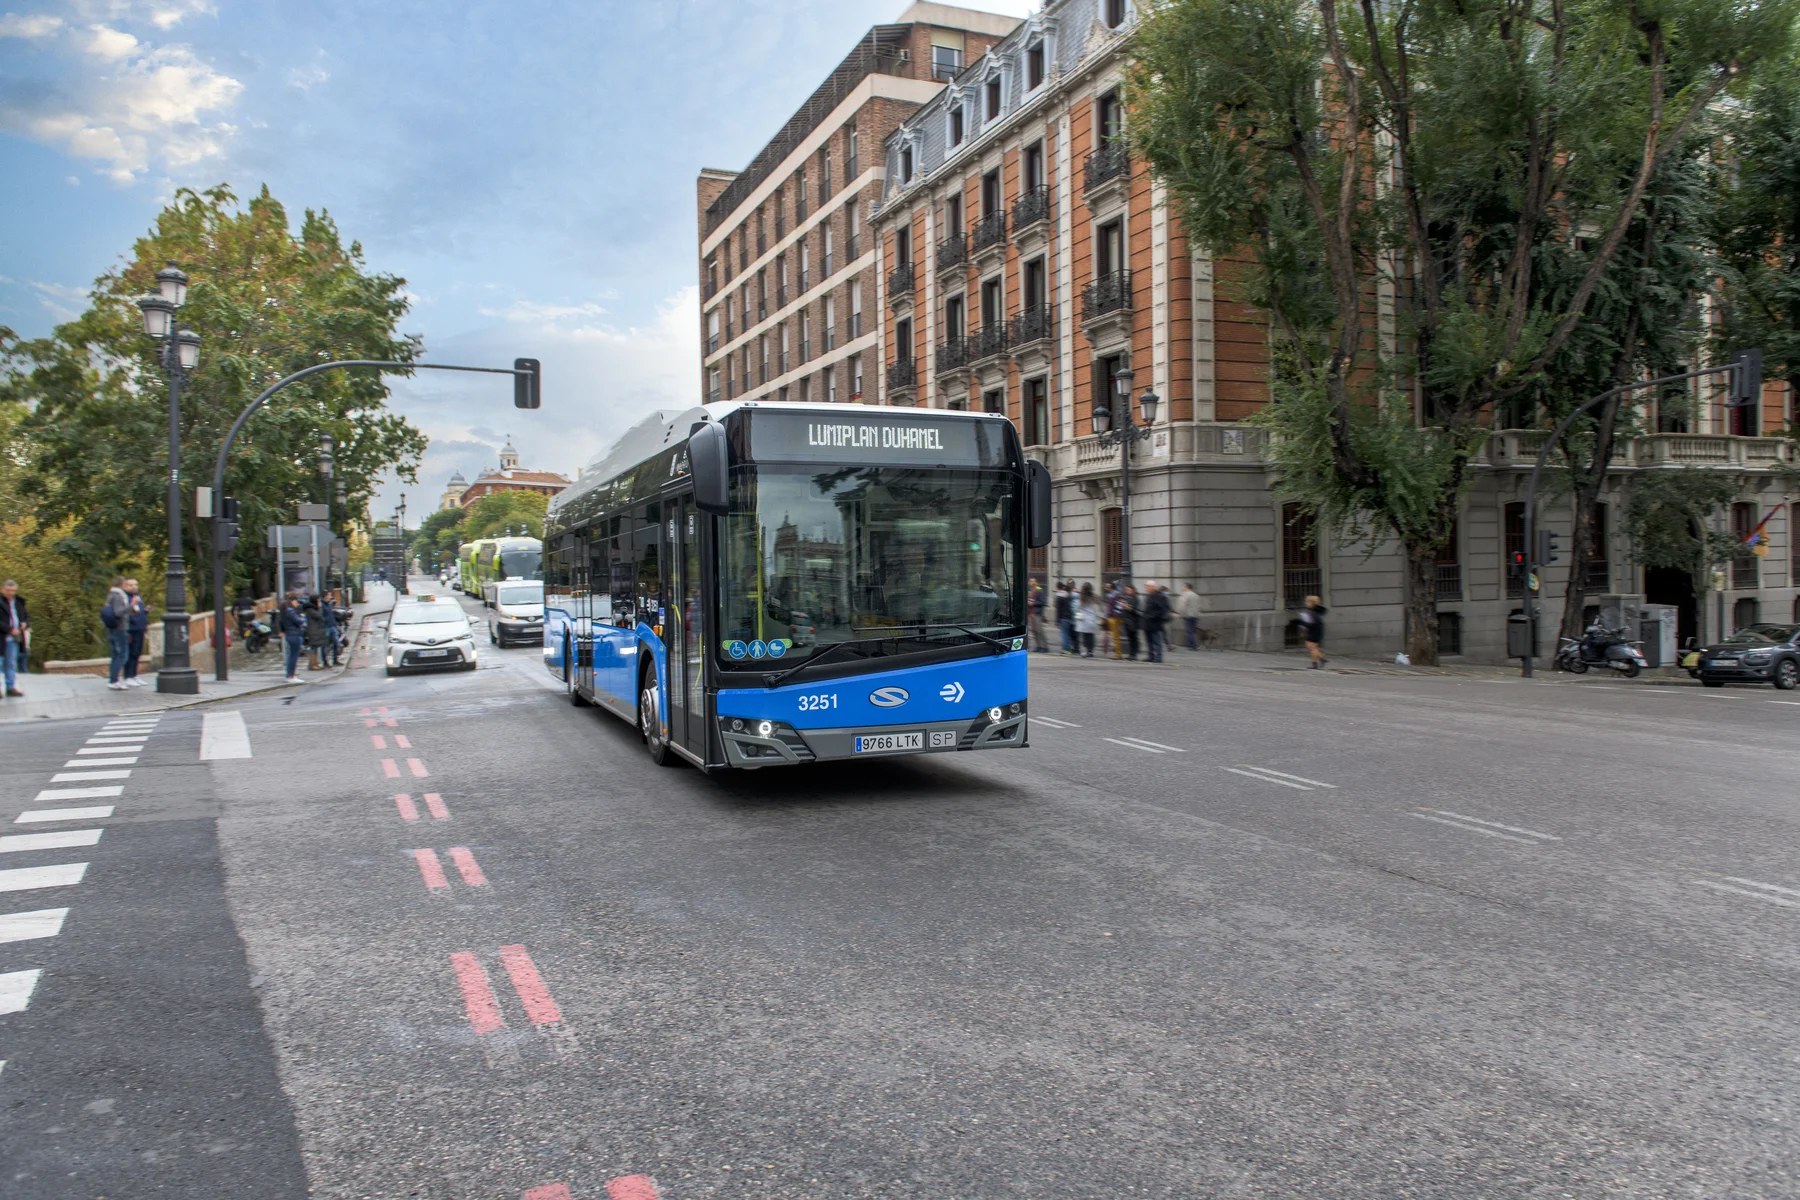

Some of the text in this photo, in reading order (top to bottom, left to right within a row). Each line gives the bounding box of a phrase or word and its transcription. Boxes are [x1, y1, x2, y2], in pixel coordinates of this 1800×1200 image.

[808, 423, 944, 450] LUMIPLAN DUHAMEL
[798, 693, 838, 711] 3251
[862, 734, 919, 750] 9766 LTK
[932, 733, 953, 746] SP
